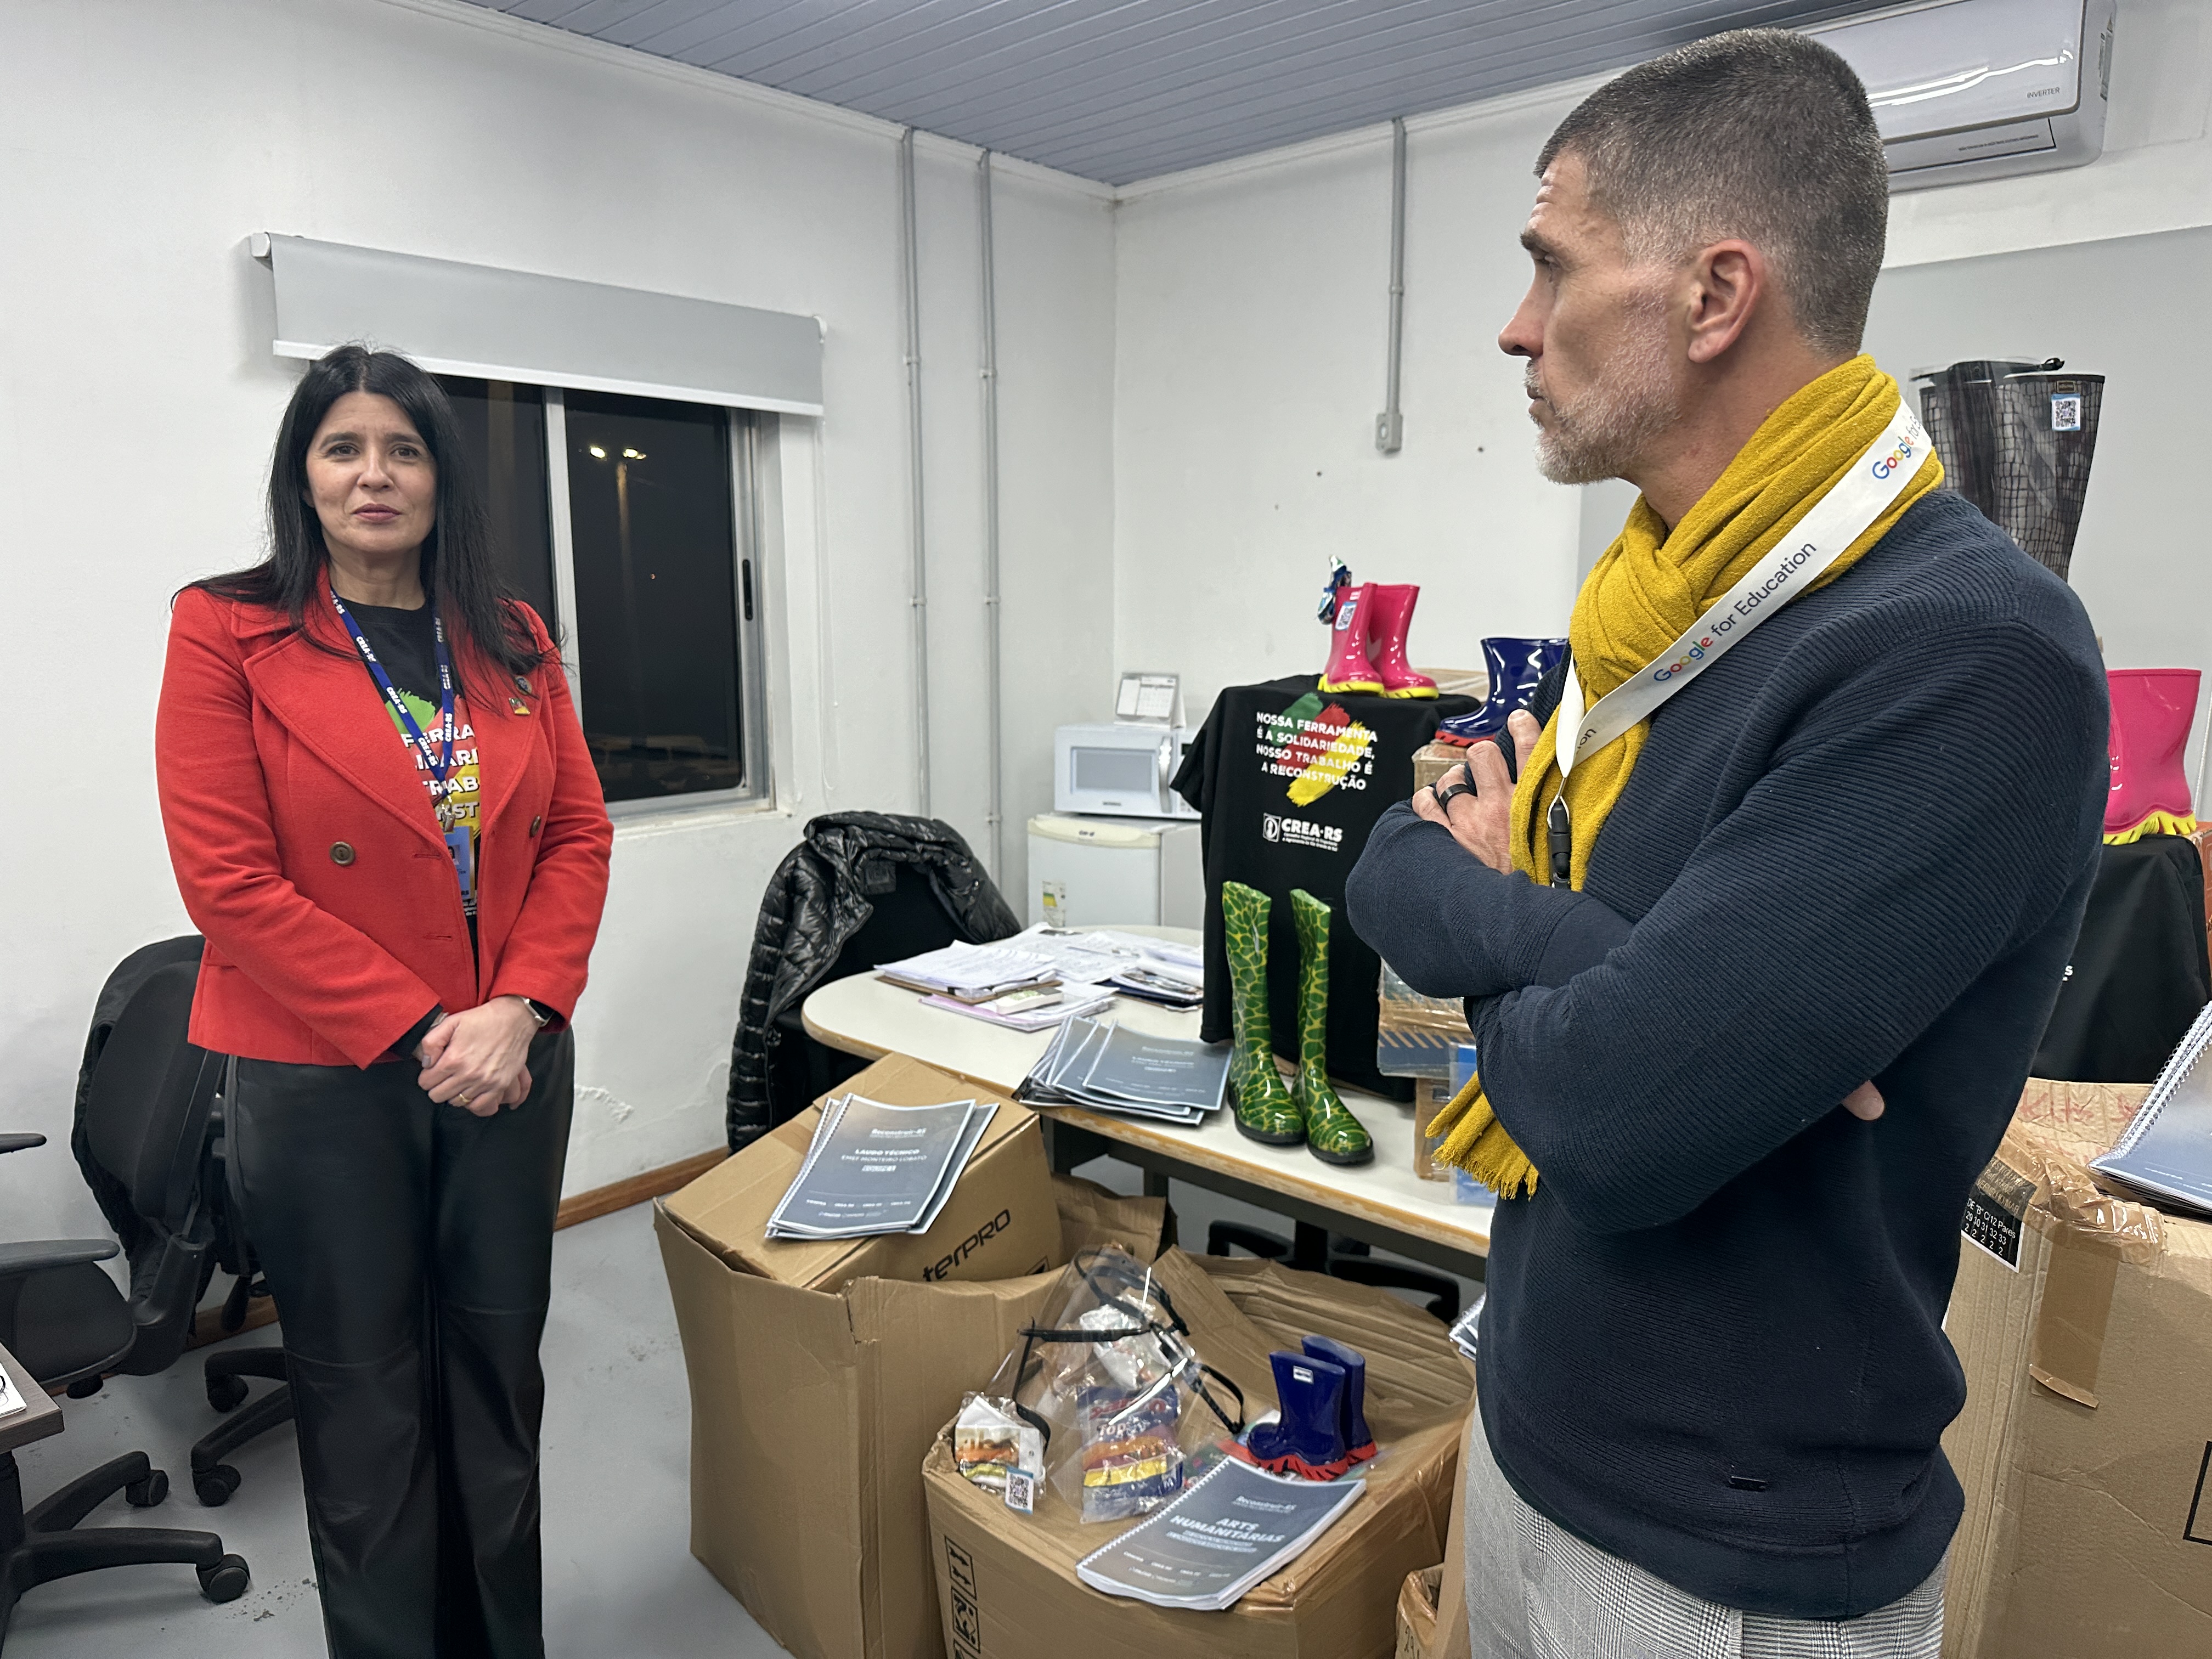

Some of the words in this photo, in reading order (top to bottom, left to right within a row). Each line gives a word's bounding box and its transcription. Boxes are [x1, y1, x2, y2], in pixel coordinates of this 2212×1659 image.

[2027, 87, 2060, 98] INVERTER
[1872, 436, 1914, 479] Google
[1654, 635, 1714, 683] Google
[1711, 613, 1737, 637] for
[1733, 541, 1817, 617] Education
[1256, 712, 1293, 729] NOSSA
[1297, 719, 1378, 742] FERRAMENTA
[1257, 726, 1263, 738] É
[1265, 731, 1273, 741] A
[1277, 733, 1375, 759] SOLIDARIEDADE,
[1256, 744, 1292, 760] NOSSO
[1296, 752, 1361, 773] TRABALHO
[1364, 763, 1373, 775] É
[1261, 763, 1268, 772] A
[1270, 764, 1367, 791] RECONSTRUÇÃO
[1964, 1223, 1969, 1232] 2
[1972, 1229, 1976, 1238] 2
[1980, 1235, 1985, 1244] 2
[1989, 1240, 1994, 1250] 2
[1999, 1247, 2003, 1256] 2
[1966, 1211, 1973, 1221] 29
[1973, 1216, 1980, 1227] 30
[1981, 1222, 1988, 1233] 31
[1989, 1228, 1997, 1239] 32
[1998, 1234, 2006, 1245] 33
[1997, 1221, 2016, 1239] Pares
[1216, 1517, 1260, 1531] ARTS
